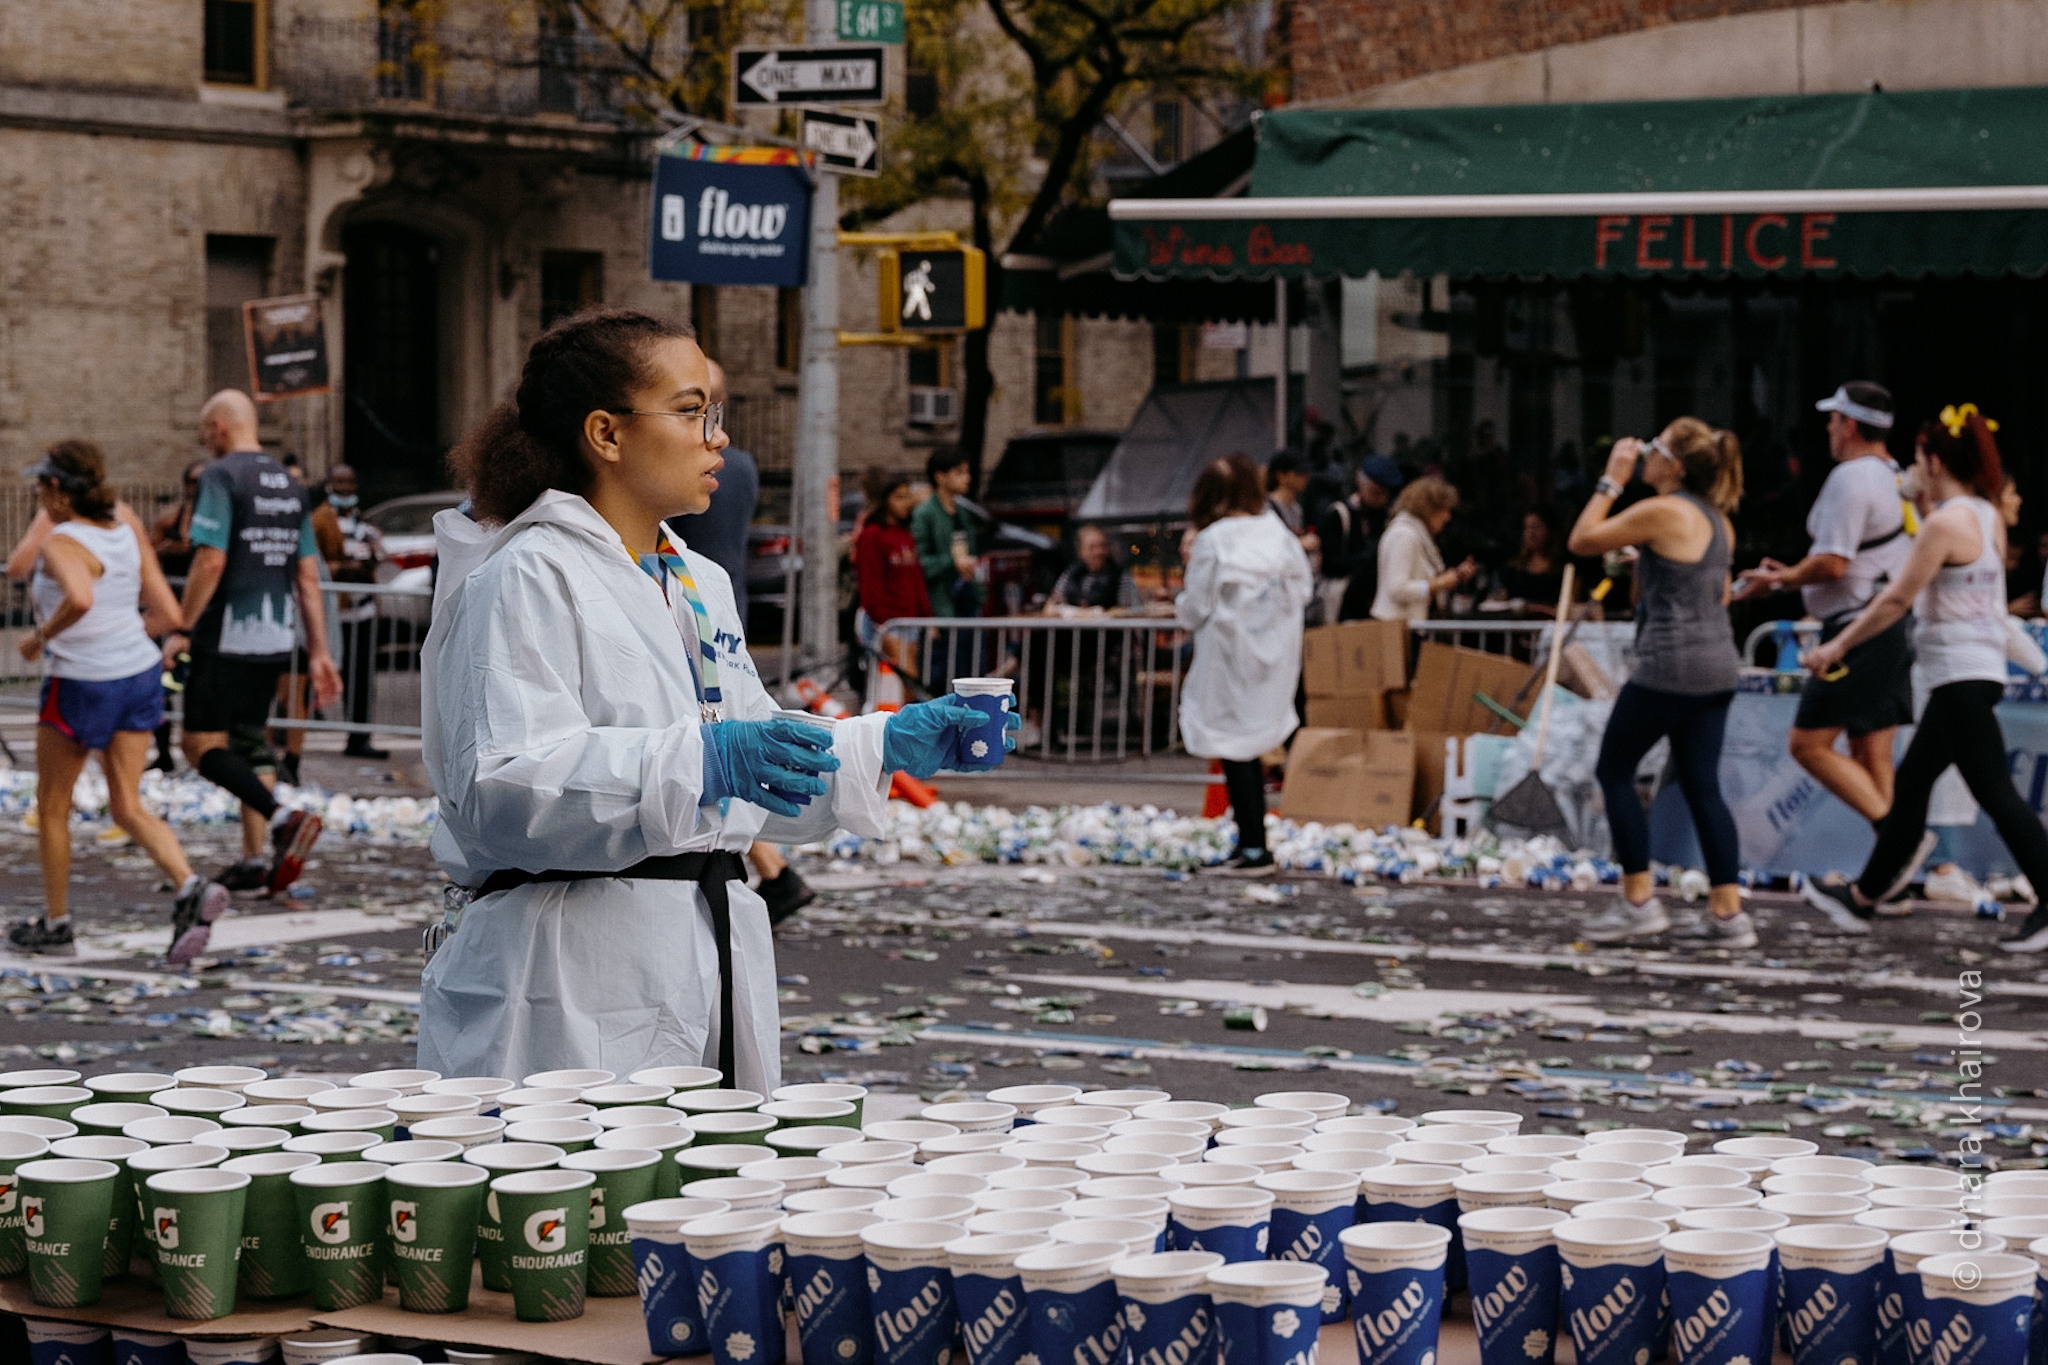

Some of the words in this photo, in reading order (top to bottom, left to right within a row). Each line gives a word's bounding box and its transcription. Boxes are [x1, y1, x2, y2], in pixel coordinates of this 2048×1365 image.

[841, 1, 852, 36] E
[756, 66, 798, 89] ONE
[698, 185, 787, 240] flow
[1595, 213, 1837, 271] FELICE
[310, 1201, 352, 1245] G
[390, 1199, 418, 1243] G
[523, 1207, 568, 1253] G
[306, 1242, 375, 1261] ENDURANCE
[512, 1249, 585, 1270] ENDURANCE
[875, 1279, 942, 1354] flow
[1356, 1280, 1425, 1358] flow
[1570, 1276, 1637, 1352] flow
